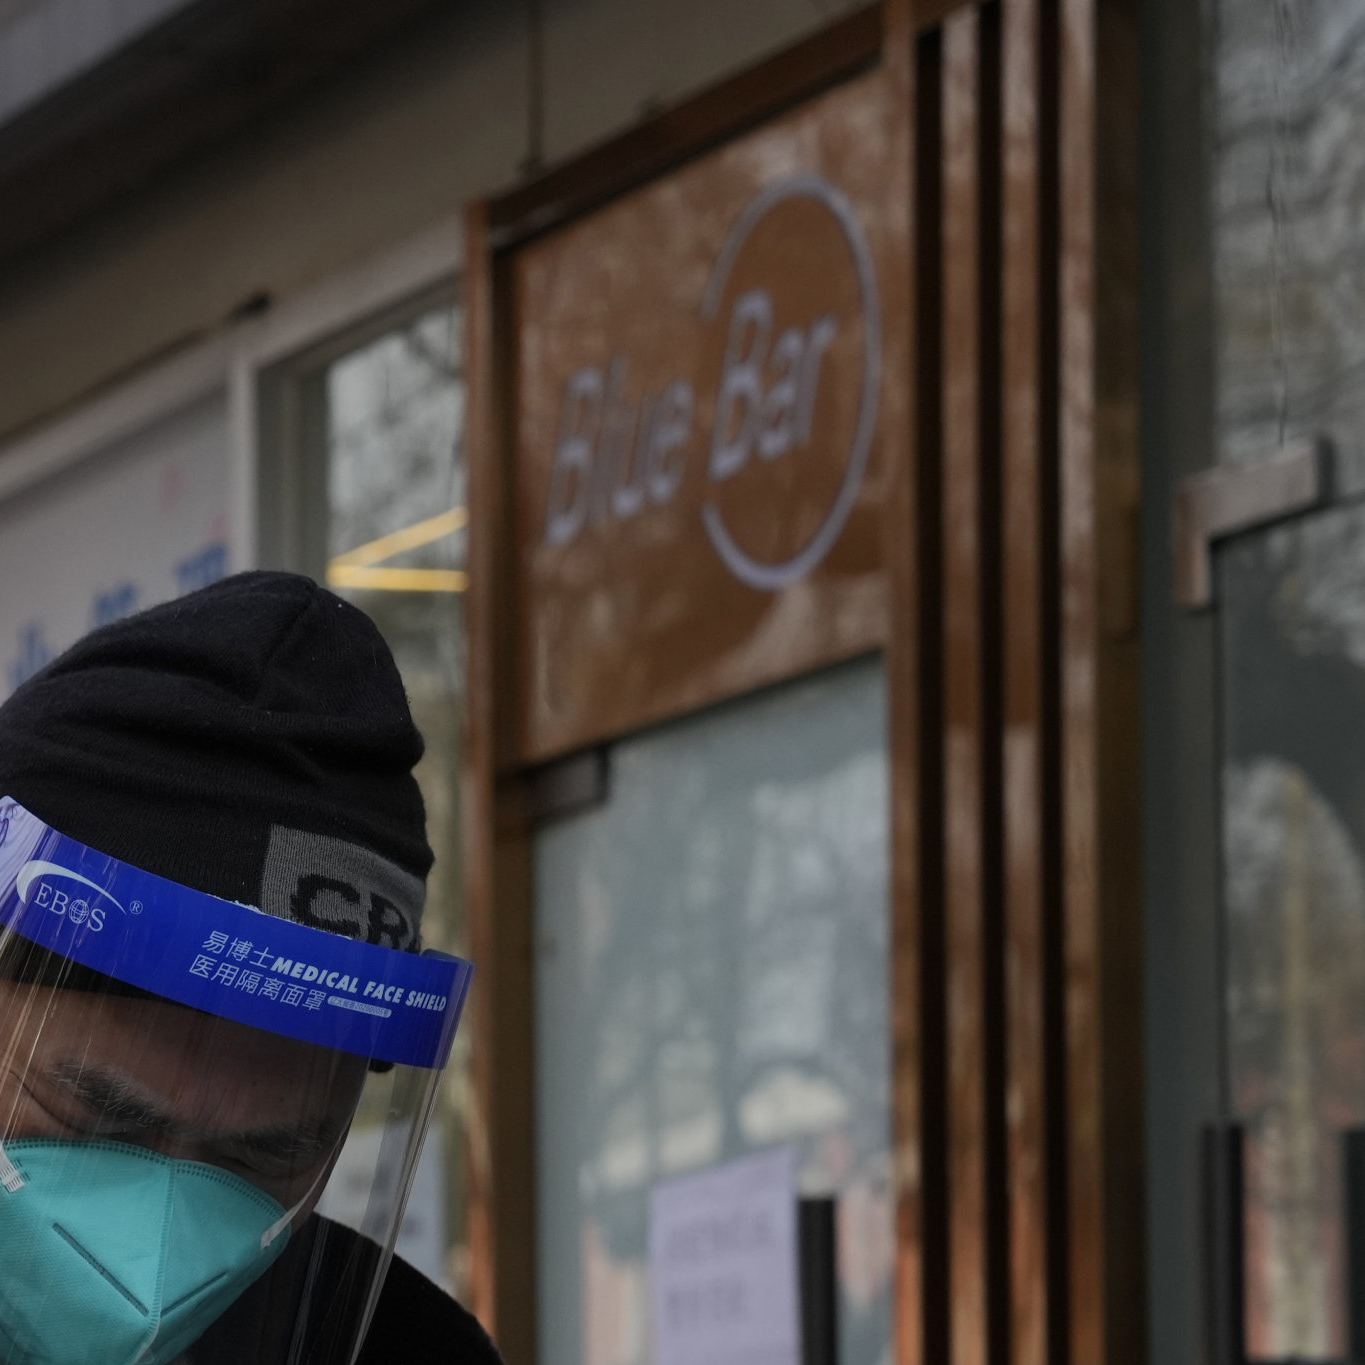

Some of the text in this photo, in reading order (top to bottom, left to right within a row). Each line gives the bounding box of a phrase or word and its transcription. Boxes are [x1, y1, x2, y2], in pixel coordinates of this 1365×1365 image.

[544, 289, 840, 547] Blue Bar
[33, 881, 106, 932] EBOS
[188, 953, 327, 1011] 医用隔离面罩
[201, 930, 447, 1012] 易博士 MEDICAL FACE SHIELD
